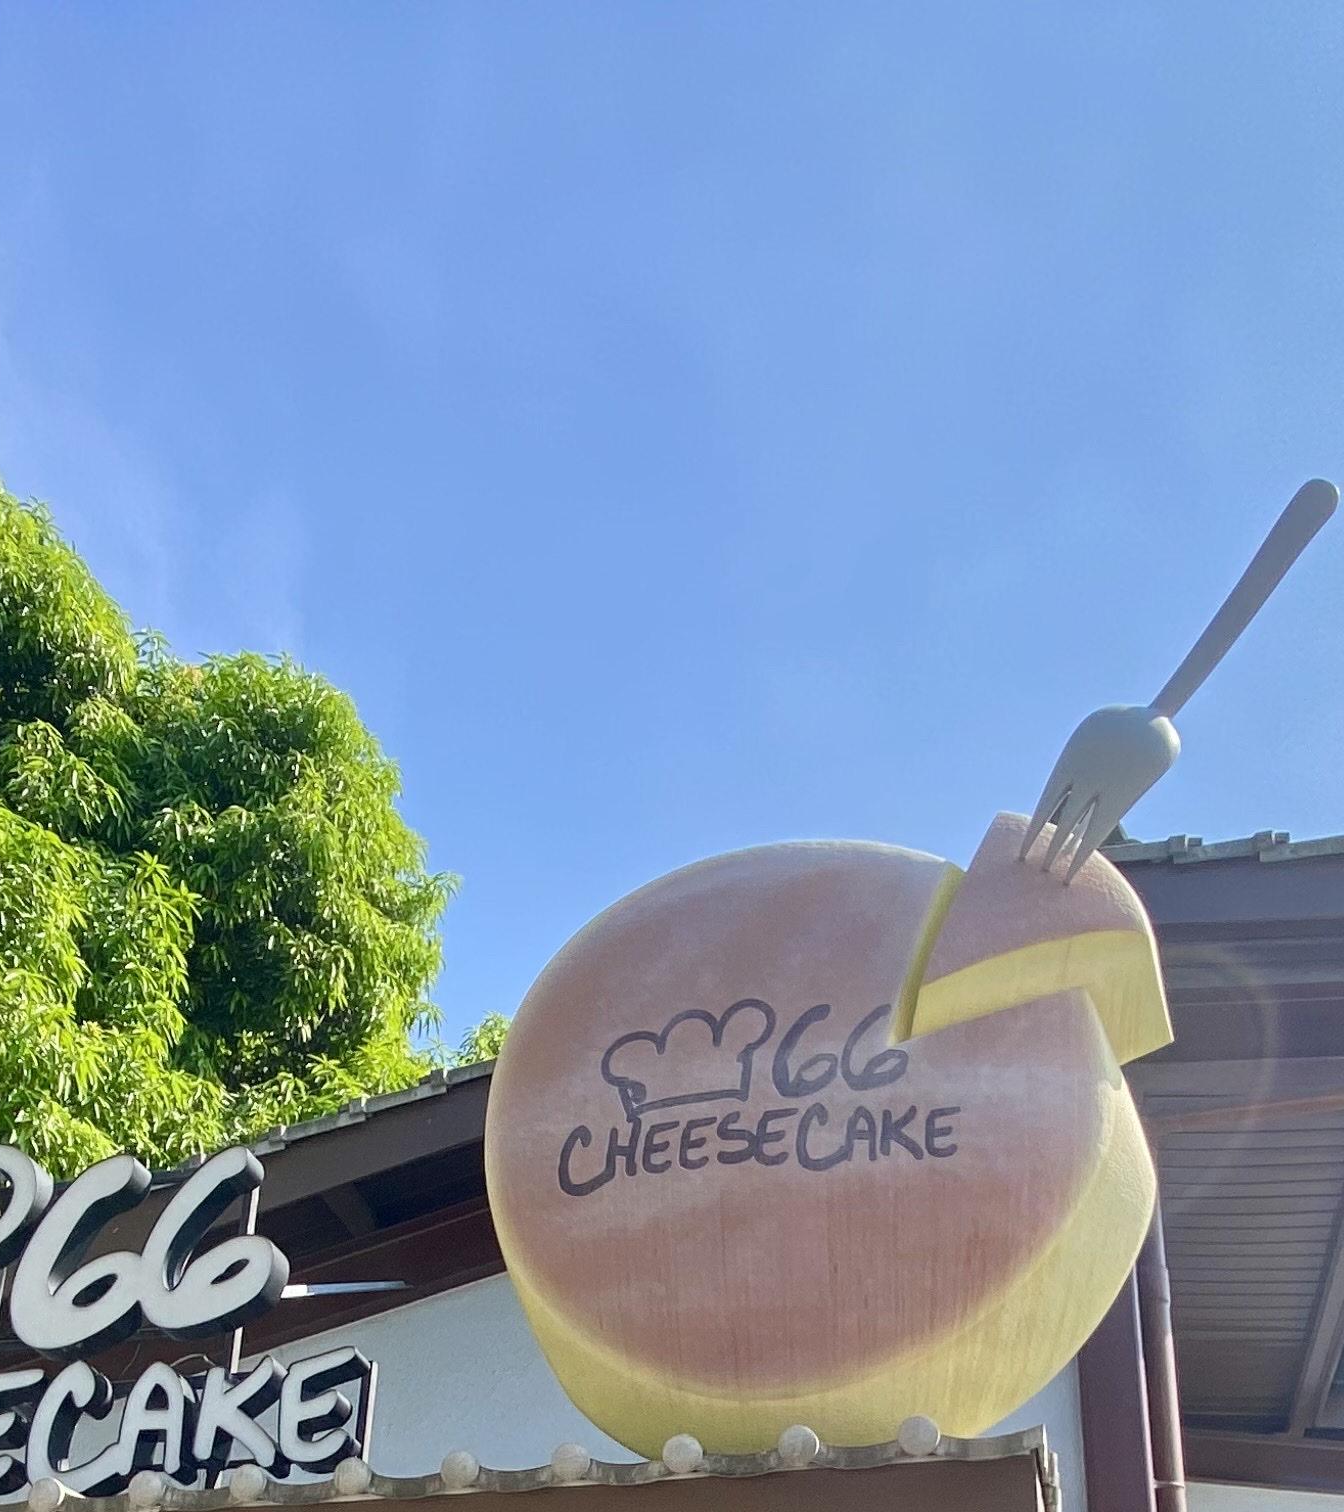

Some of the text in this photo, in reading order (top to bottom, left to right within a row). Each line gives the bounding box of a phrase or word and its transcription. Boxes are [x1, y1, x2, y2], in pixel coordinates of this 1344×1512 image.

[772, 1003, 909, 1098] 66
[558, 1102, 960, 1196] CHEESECAKE
[11, 1146, 290, 1354] 66
